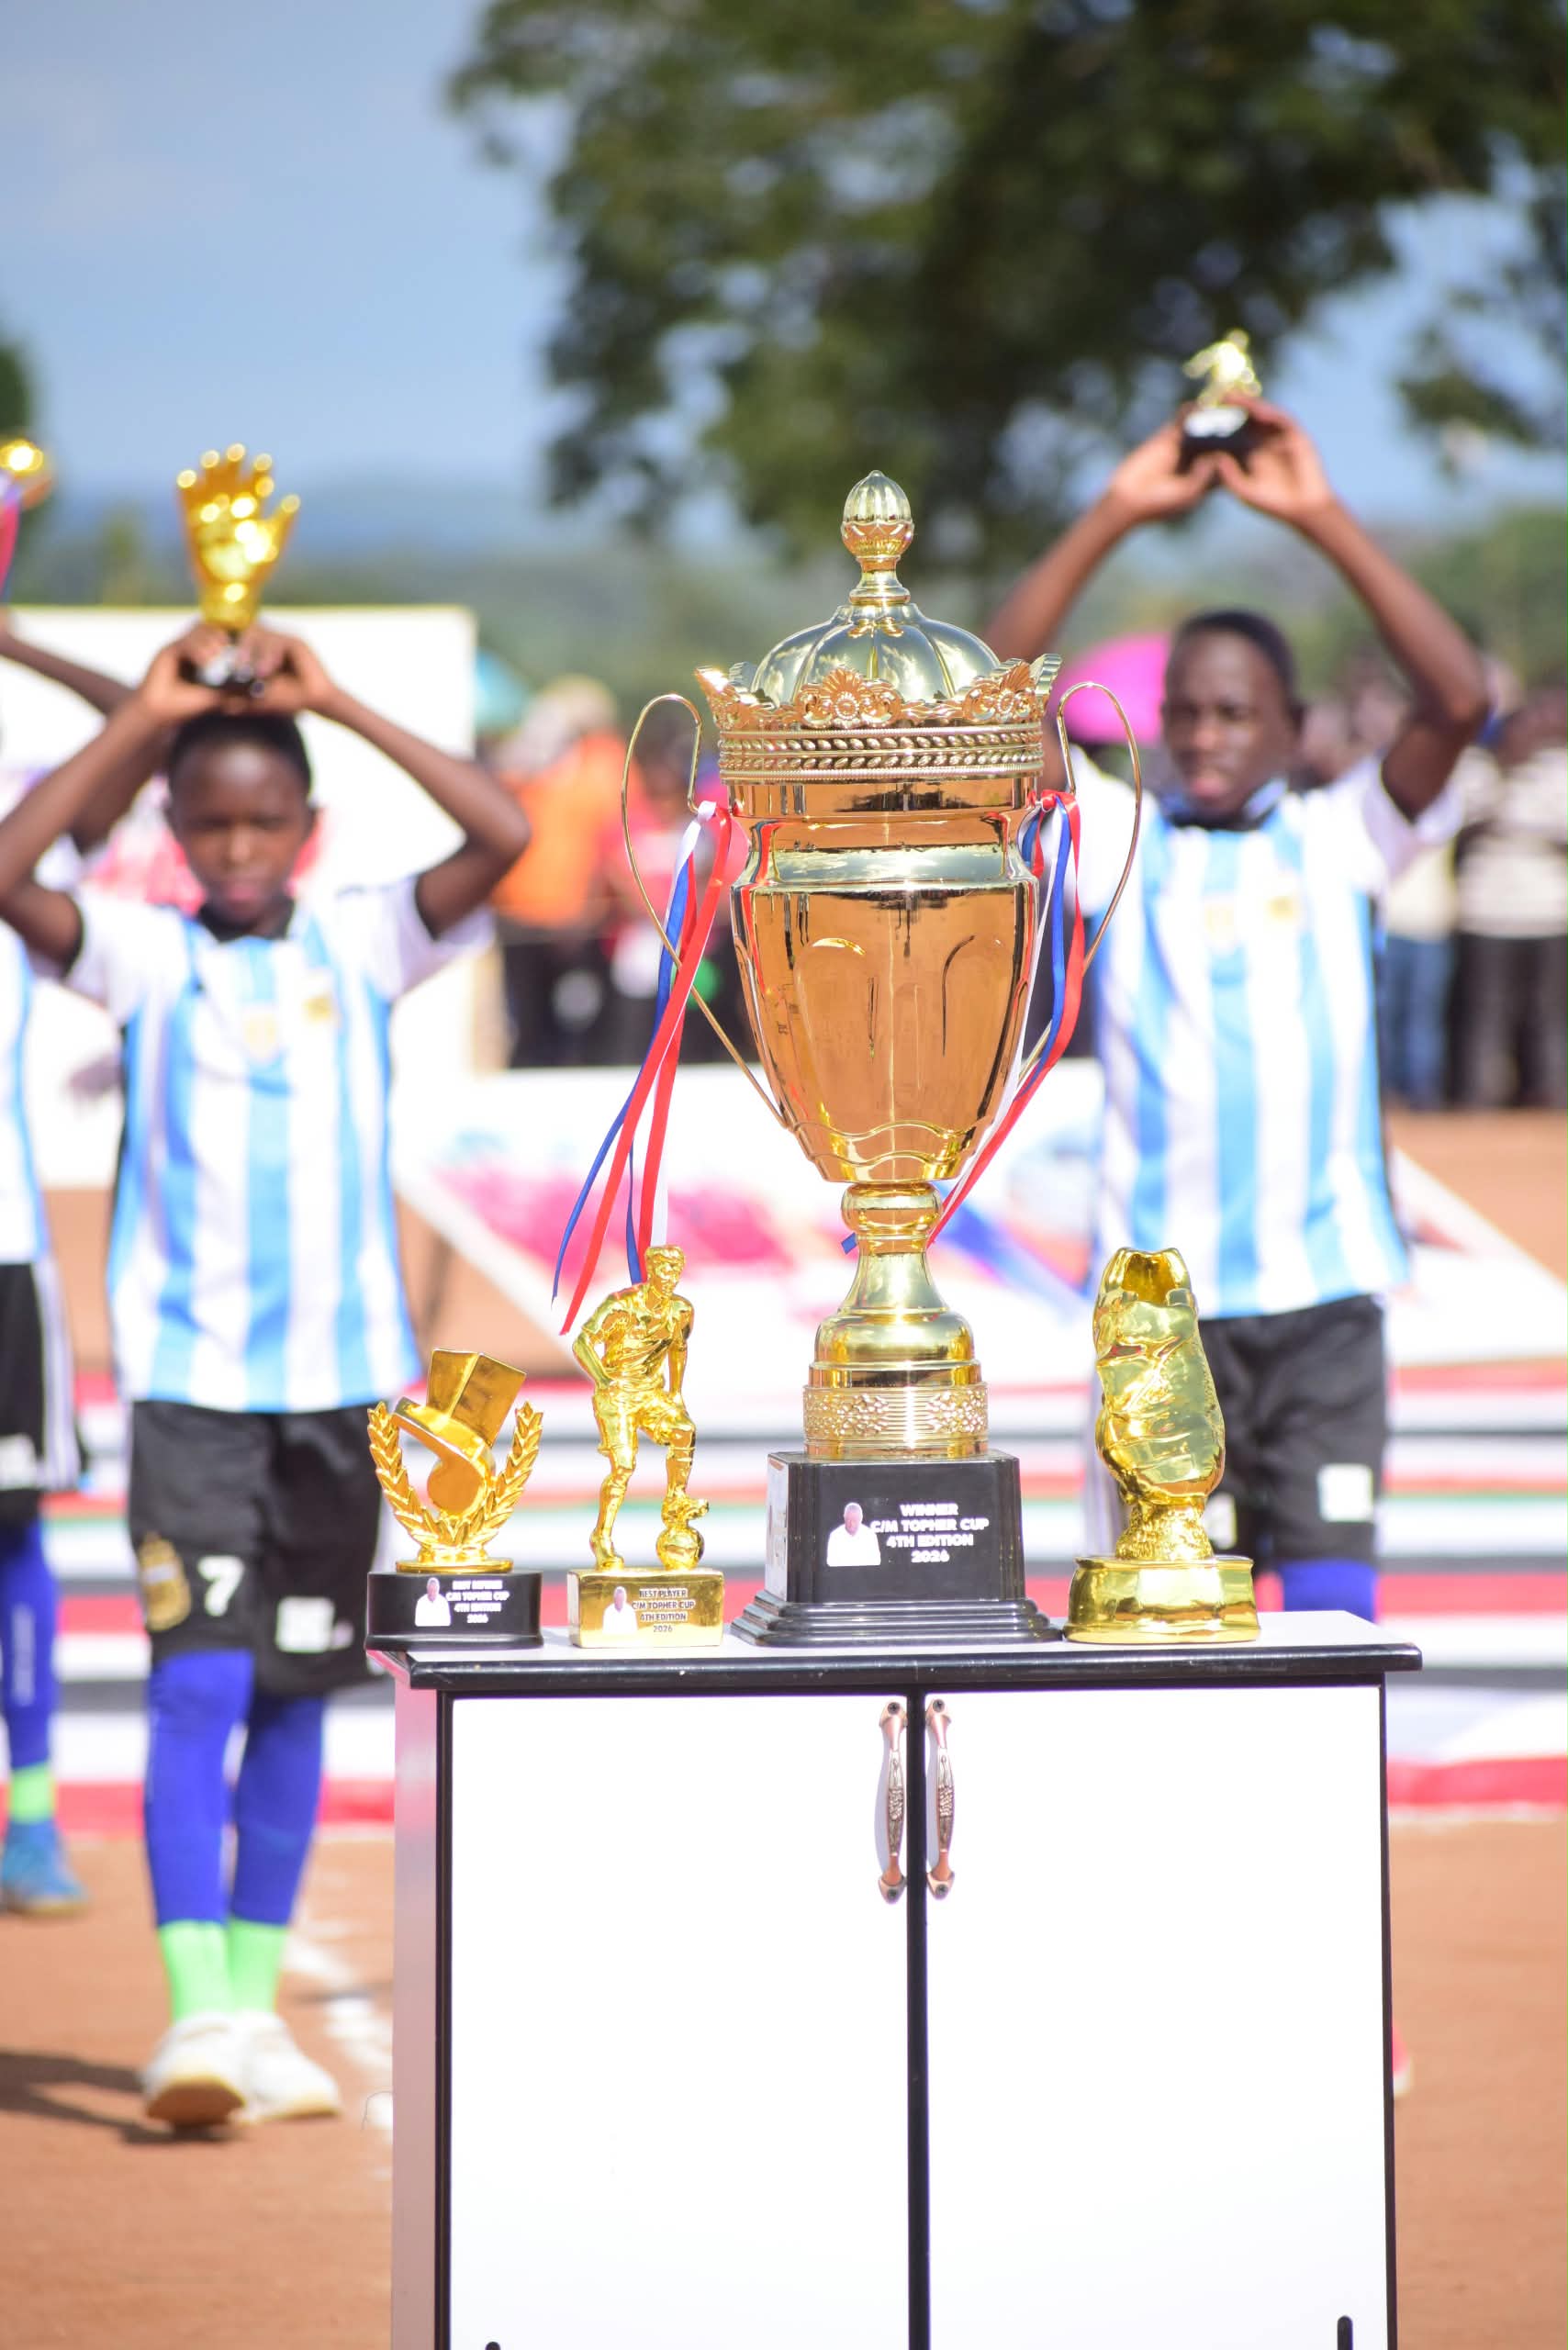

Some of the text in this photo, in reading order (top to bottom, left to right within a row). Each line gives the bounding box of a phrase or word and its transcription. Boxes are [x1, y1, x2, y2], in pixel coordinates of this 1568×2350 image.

[900, 1503, 958, 1516] WINNER
[901, 1518, 958, 1531] TOPHER
[960, 1517, 990, 1530] CUP
[886, 1534, 974, 1548] 4TH EDITION
[911, 1550, 950, 1562] 2026
[197, 1555, 245, 1617] 7
[657, 1589, 687, 1597] PLAYER
[647, 1601, 678, 1609] TOPHER
[678, 1600, 695, 1609] CUP
[655, 1613, 687, 1621] EDITION
